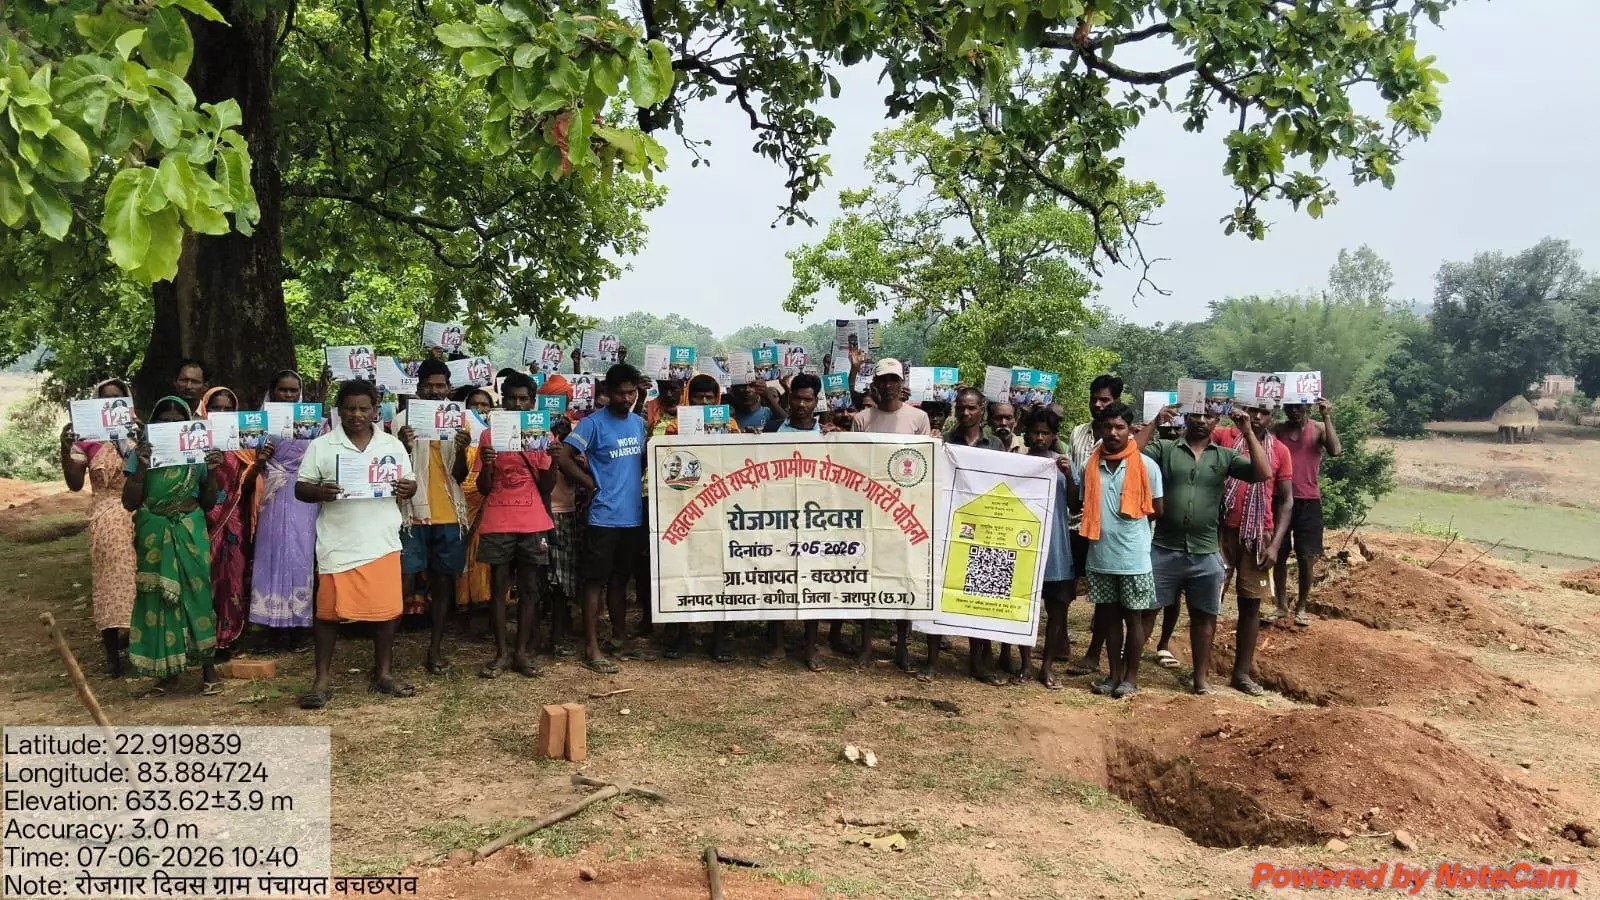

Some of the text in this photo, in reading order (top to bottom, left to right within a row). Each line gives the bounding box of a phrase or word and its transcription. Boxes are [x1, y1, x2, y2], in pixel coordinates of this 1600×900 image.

[443, 332, 461, 346] 125
[601, 341, 618, 352] 125
[676, 348, 690, 357] 125
[351, 353, 372, 369] 125
[543, 348, 561, 362] 125
[758, 349, 773, 359] 125
[786, 354, 804, 367] 125
[469, 364, 490, 380] 125
[1017, 371, 1032, 382] 125
[1039, 372, 1053, 383] 125
[828, 375, 843, 385] 125
[1213, 382, 1229, 392] 125
[1297, 380, 1318, 394] 125
[572, 384, 592, 400] 125
[1258, 381, 1281, 400] 125
[544, 397, 560, 406] 125
[300, 405, 316, 414] 125
[709, 407, 724, 417] 125
[103, 408, 130, 426] 125
[245, 413, 262, 423] 125
[437, 412, 462, 428] 125
[527, 413, 544, 423] 125
[181, 431, 209, 450] 125
[617, 437, 638, 448] WORK
[662, 450, 929, 546] महात्मा गांधी राष्ट्रीय ग्रामीण रोजगार गारंटी योजना
[726, 501, 863, 531] रोजगार दिवस
[728, 540, 773, 559] दिनांक
[723, 567, 798, 586] ग्रा.पंचायत
[810, 566, 869, 584] बच्छरांव
[676, 594, 713, 607] जनपद
[803, 588, 831, 604] जिला
[841, 591, 876, 606] जशपुर
